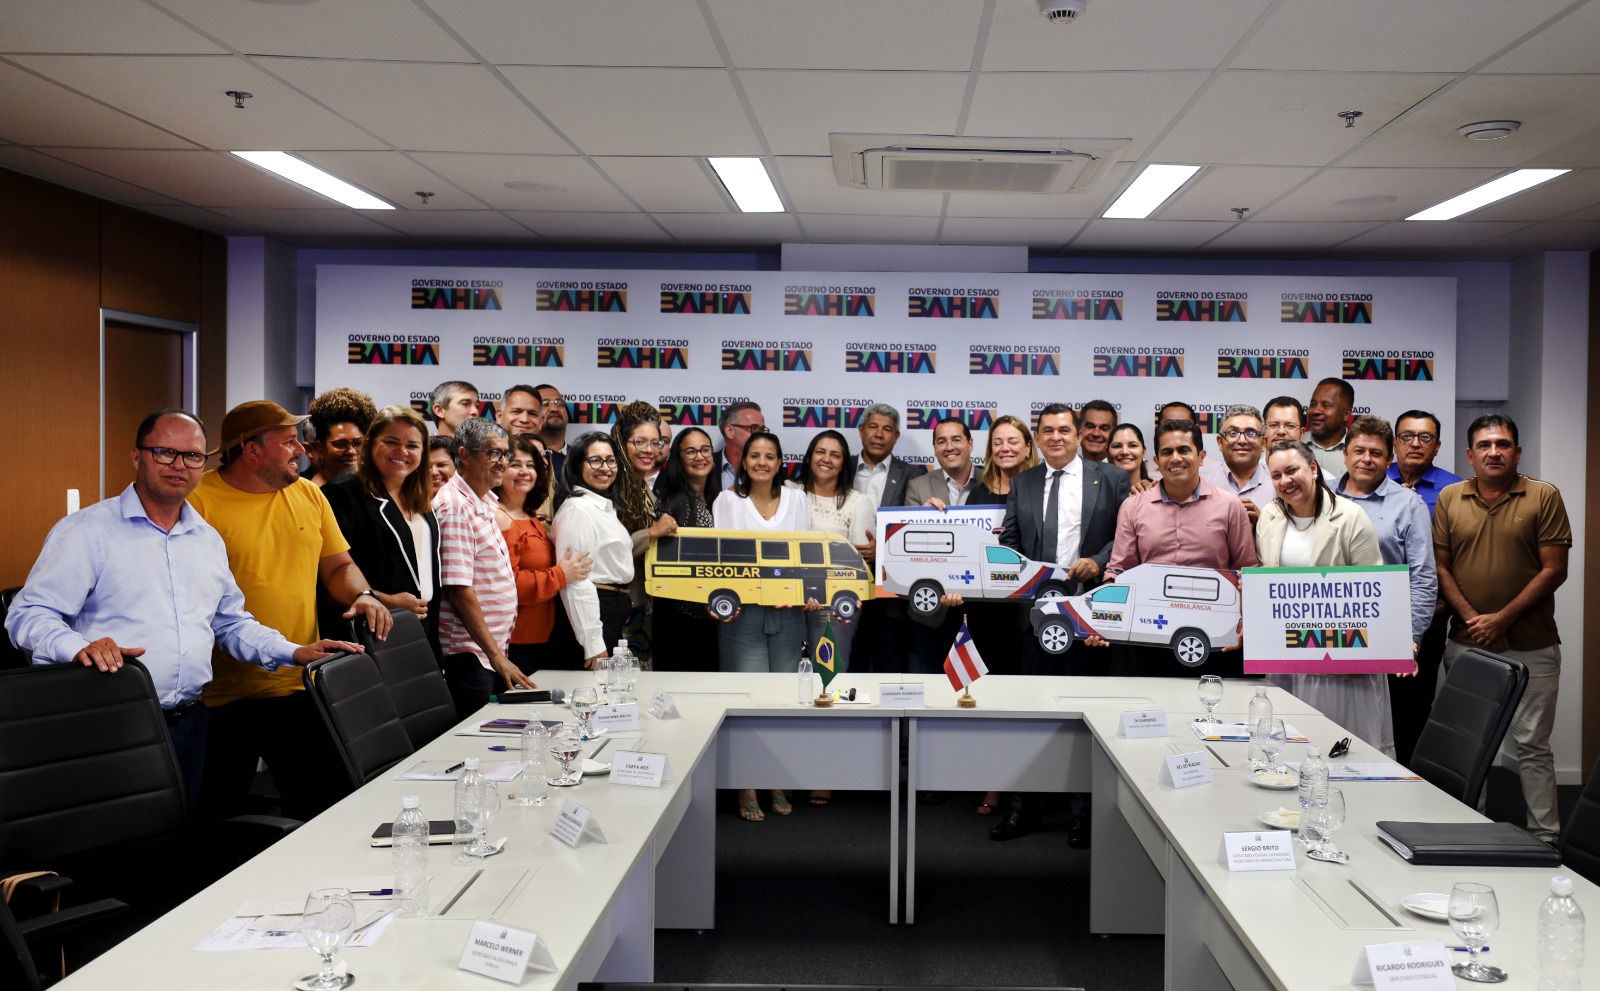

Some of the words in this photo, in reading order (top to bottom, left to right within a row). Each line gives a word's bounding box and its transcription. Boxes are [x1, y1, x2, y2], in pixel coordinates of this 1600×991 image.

[471, 280, 504, 288] ESTADO
[595, 282, 628, 290] ESTADO
[719, 284, 752, 292] ESTADO
[843, 286, 876, 294] ESTADO
[967, 288, 1000, 296] ESTADO
[1091, 290, 1124, 298] ESTADO
[412, 288, 503, 310] BAHIA
[536, 290, 627, 312] BAHIA
[1216, 292, 1248, 300] ESTADO
[1340, 294, 1372, 302] ESTADO
[660, 292, 751, 314] BAHIA
[784, 294, 875, 316] BAHIA
[908, 296, 999, 318] BAHIA
[1032, 298, 1123, 320] BAHIA
[1157, 300, 1248, 322] BAHIA
[1281, 302, 1372, 323] BAHIA
[407, 335, 440, 343] ESTADO
[532, 337, 564, 345] ESTADO
[656, 339, 688, 347] ESTADO
[780, 341, 812, 349] ESTADO
[904, 343, 936, 351] ESTADO
[1028, 345, 1060, 353] ESTADO
[348, 343, 439, 364] BAHIA
[473, 345, 564, 366] BAHIA
[1152, 347, 1184, 355] ESTADO
[1277, 349, 1310, 357] ESTADO
[1402, 351, 1434, 360] ESTADO
[597, 347, 688, 368] BAHIA
[721, 349, 812, 370] BAHIA
[845, 351, 936, 372] BAHIA
[969, 353, 1060, 374] BAHIA
[1093, 355, 1184, 376] BAHIA
[1218, 357, 1309, 378] BAHIA
[1343, 359, 1434, 381] BAHIA
[659, 396, 701, 404] GOVERNO
[783, 398, 824, 406] GOVERNO
[842, 399, 874, 407] ESTADO
[907, 400, 948, 408] GOVERNO
[696, 566, 760, 578] ESCOLAR
[1269, 582, 1382, 599] EQUIPAMENTOS
[1170, 602, 1212, 611] AMBULÂNCIA
[1272, 602, 1380, 619] HOSPITALARES
[1286, 629, 1368, 648] BAHIA
[474, 939, 500, 950] MARCELO
[500, 946, 523, 957] WERNER
[1376, 963, 1405, 971] RICARDO
[1406, 960, 1444, 969] RODRIGUES
